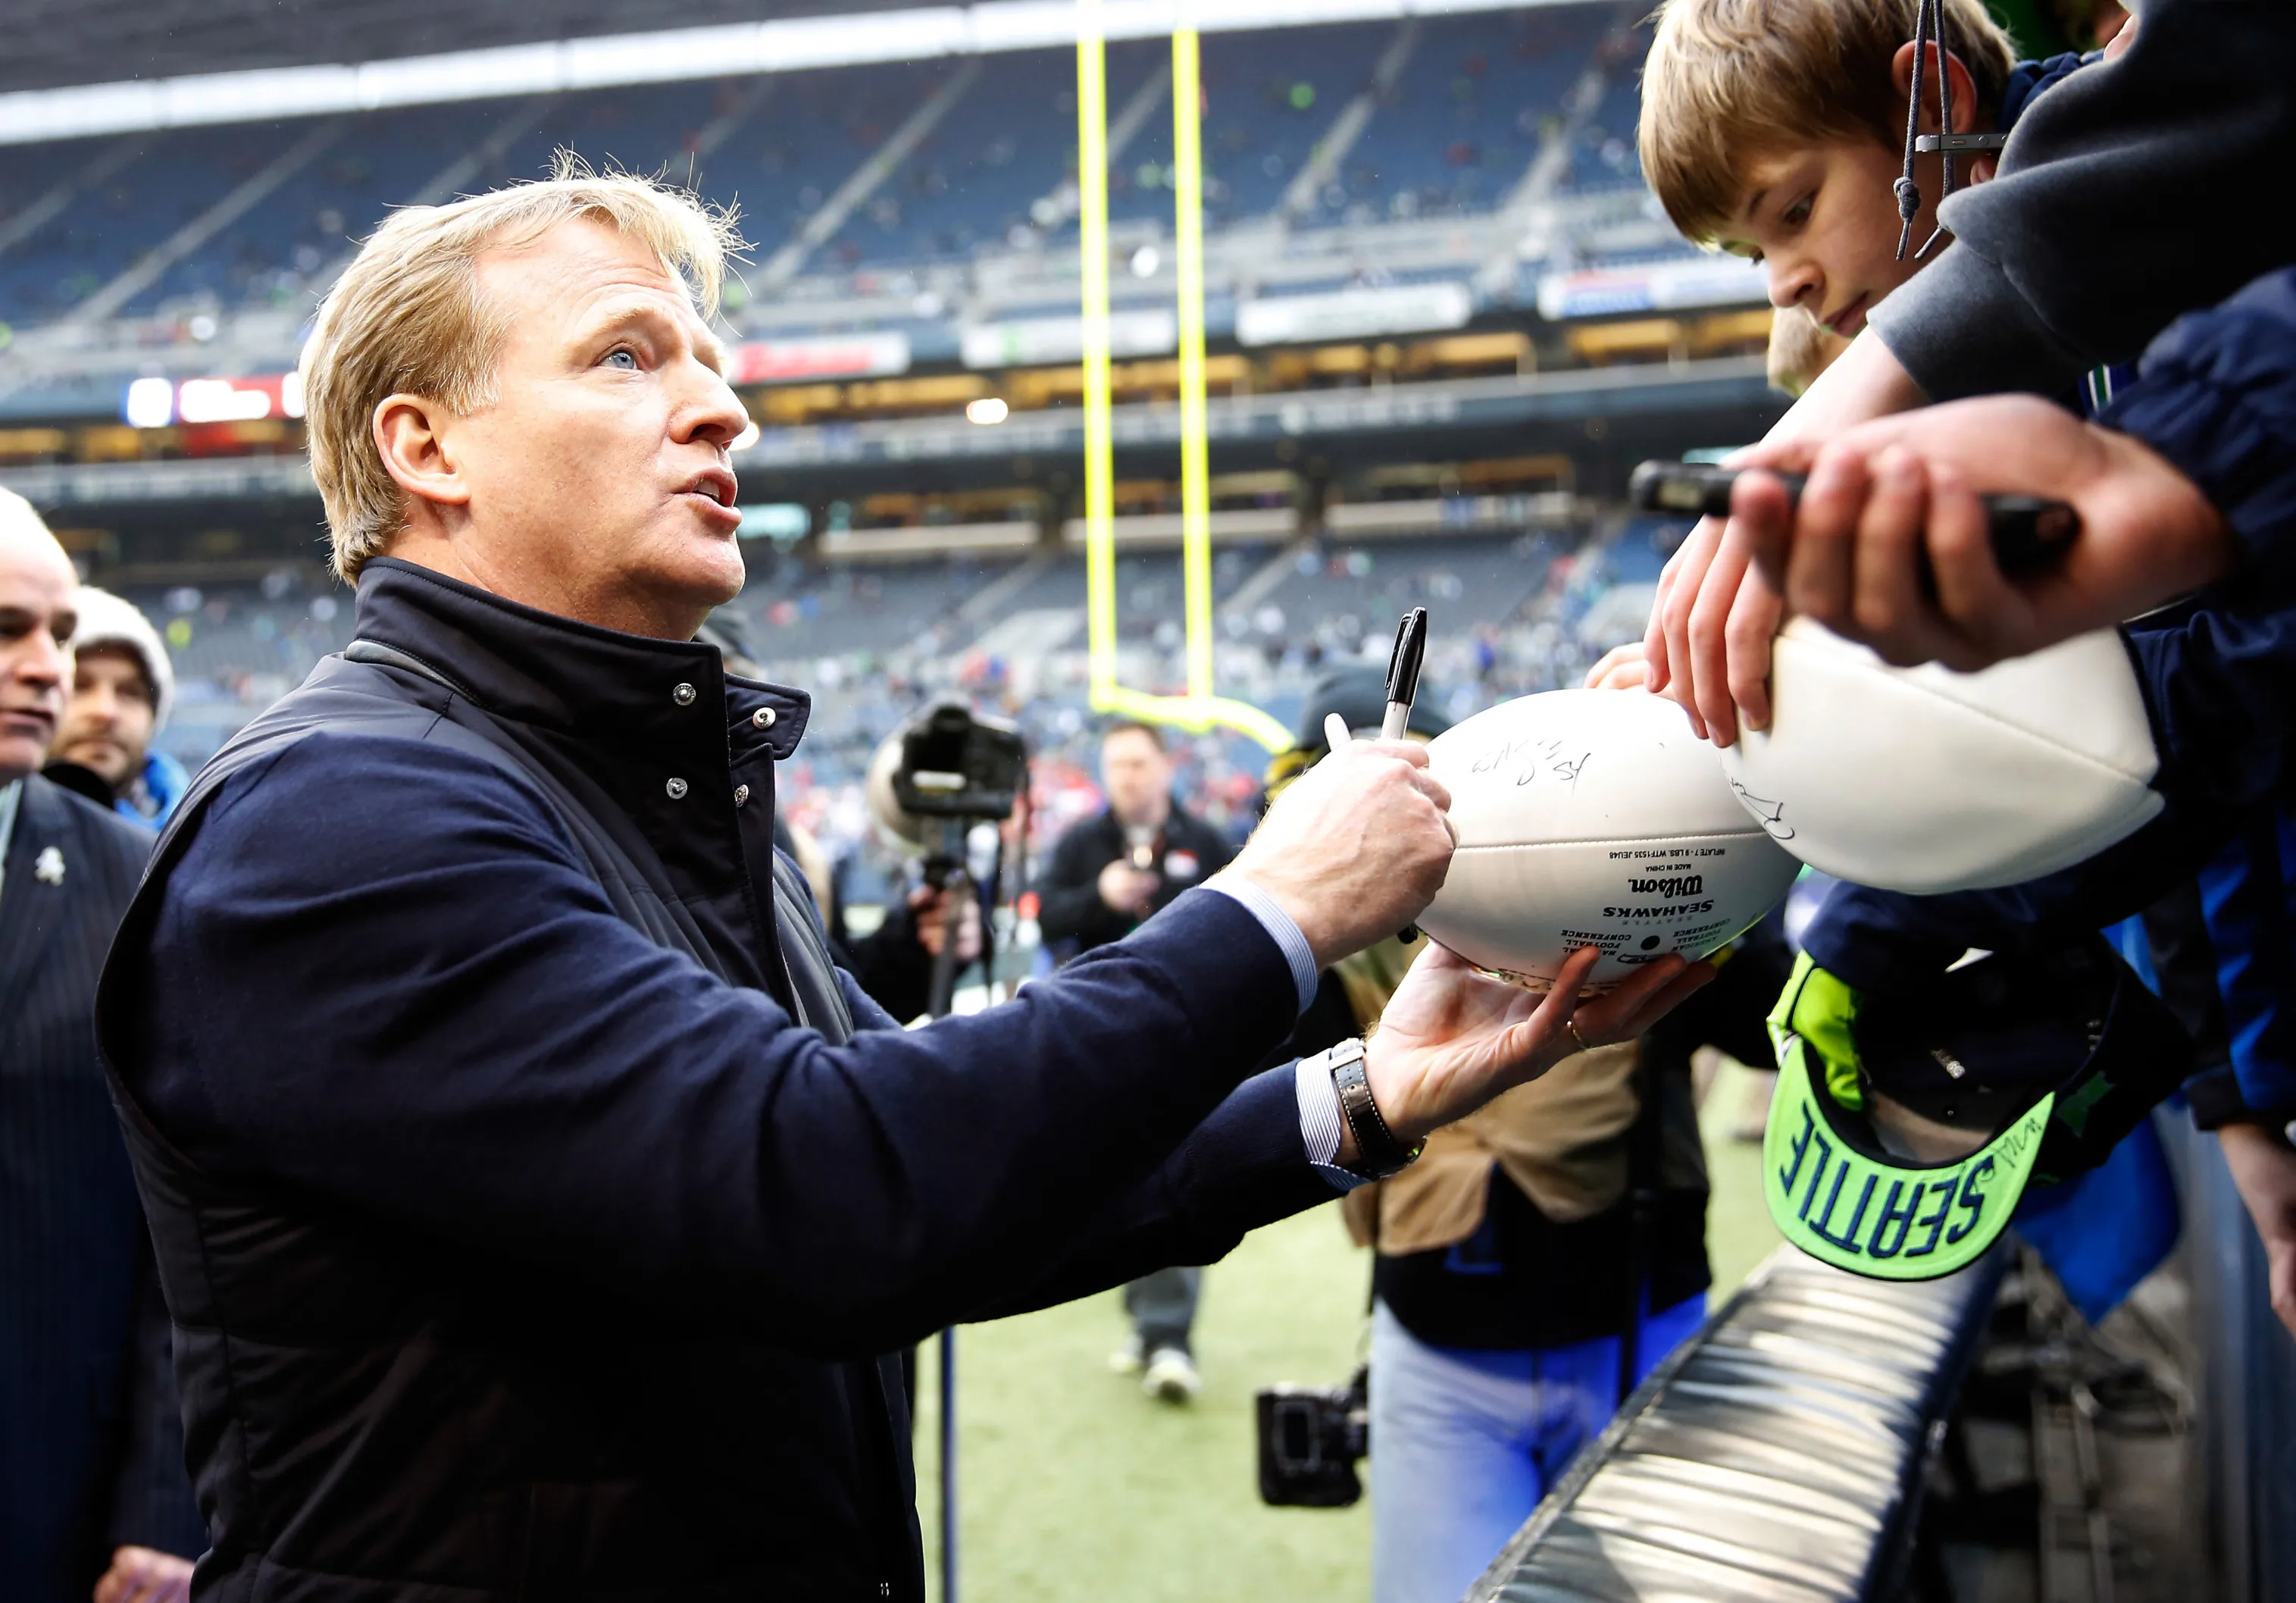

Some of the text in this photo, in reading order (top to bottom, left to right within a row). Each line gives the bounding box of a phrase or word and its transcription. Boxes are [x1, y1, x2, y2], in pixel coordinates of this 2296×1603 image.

[1684, 850, 1690, 858] 9
[1694, 849, 1699, 858] 7
[1700, 848, 1725, 858] INFLATE
[1622, 916, 1692, 925] SEATTLE
[1673, 918, 1731, 937] CONFERENCE
[1561, 929, 1632, 941] CONFERENCE
[1778, 1098, 1994, 1259] SEATTLE
